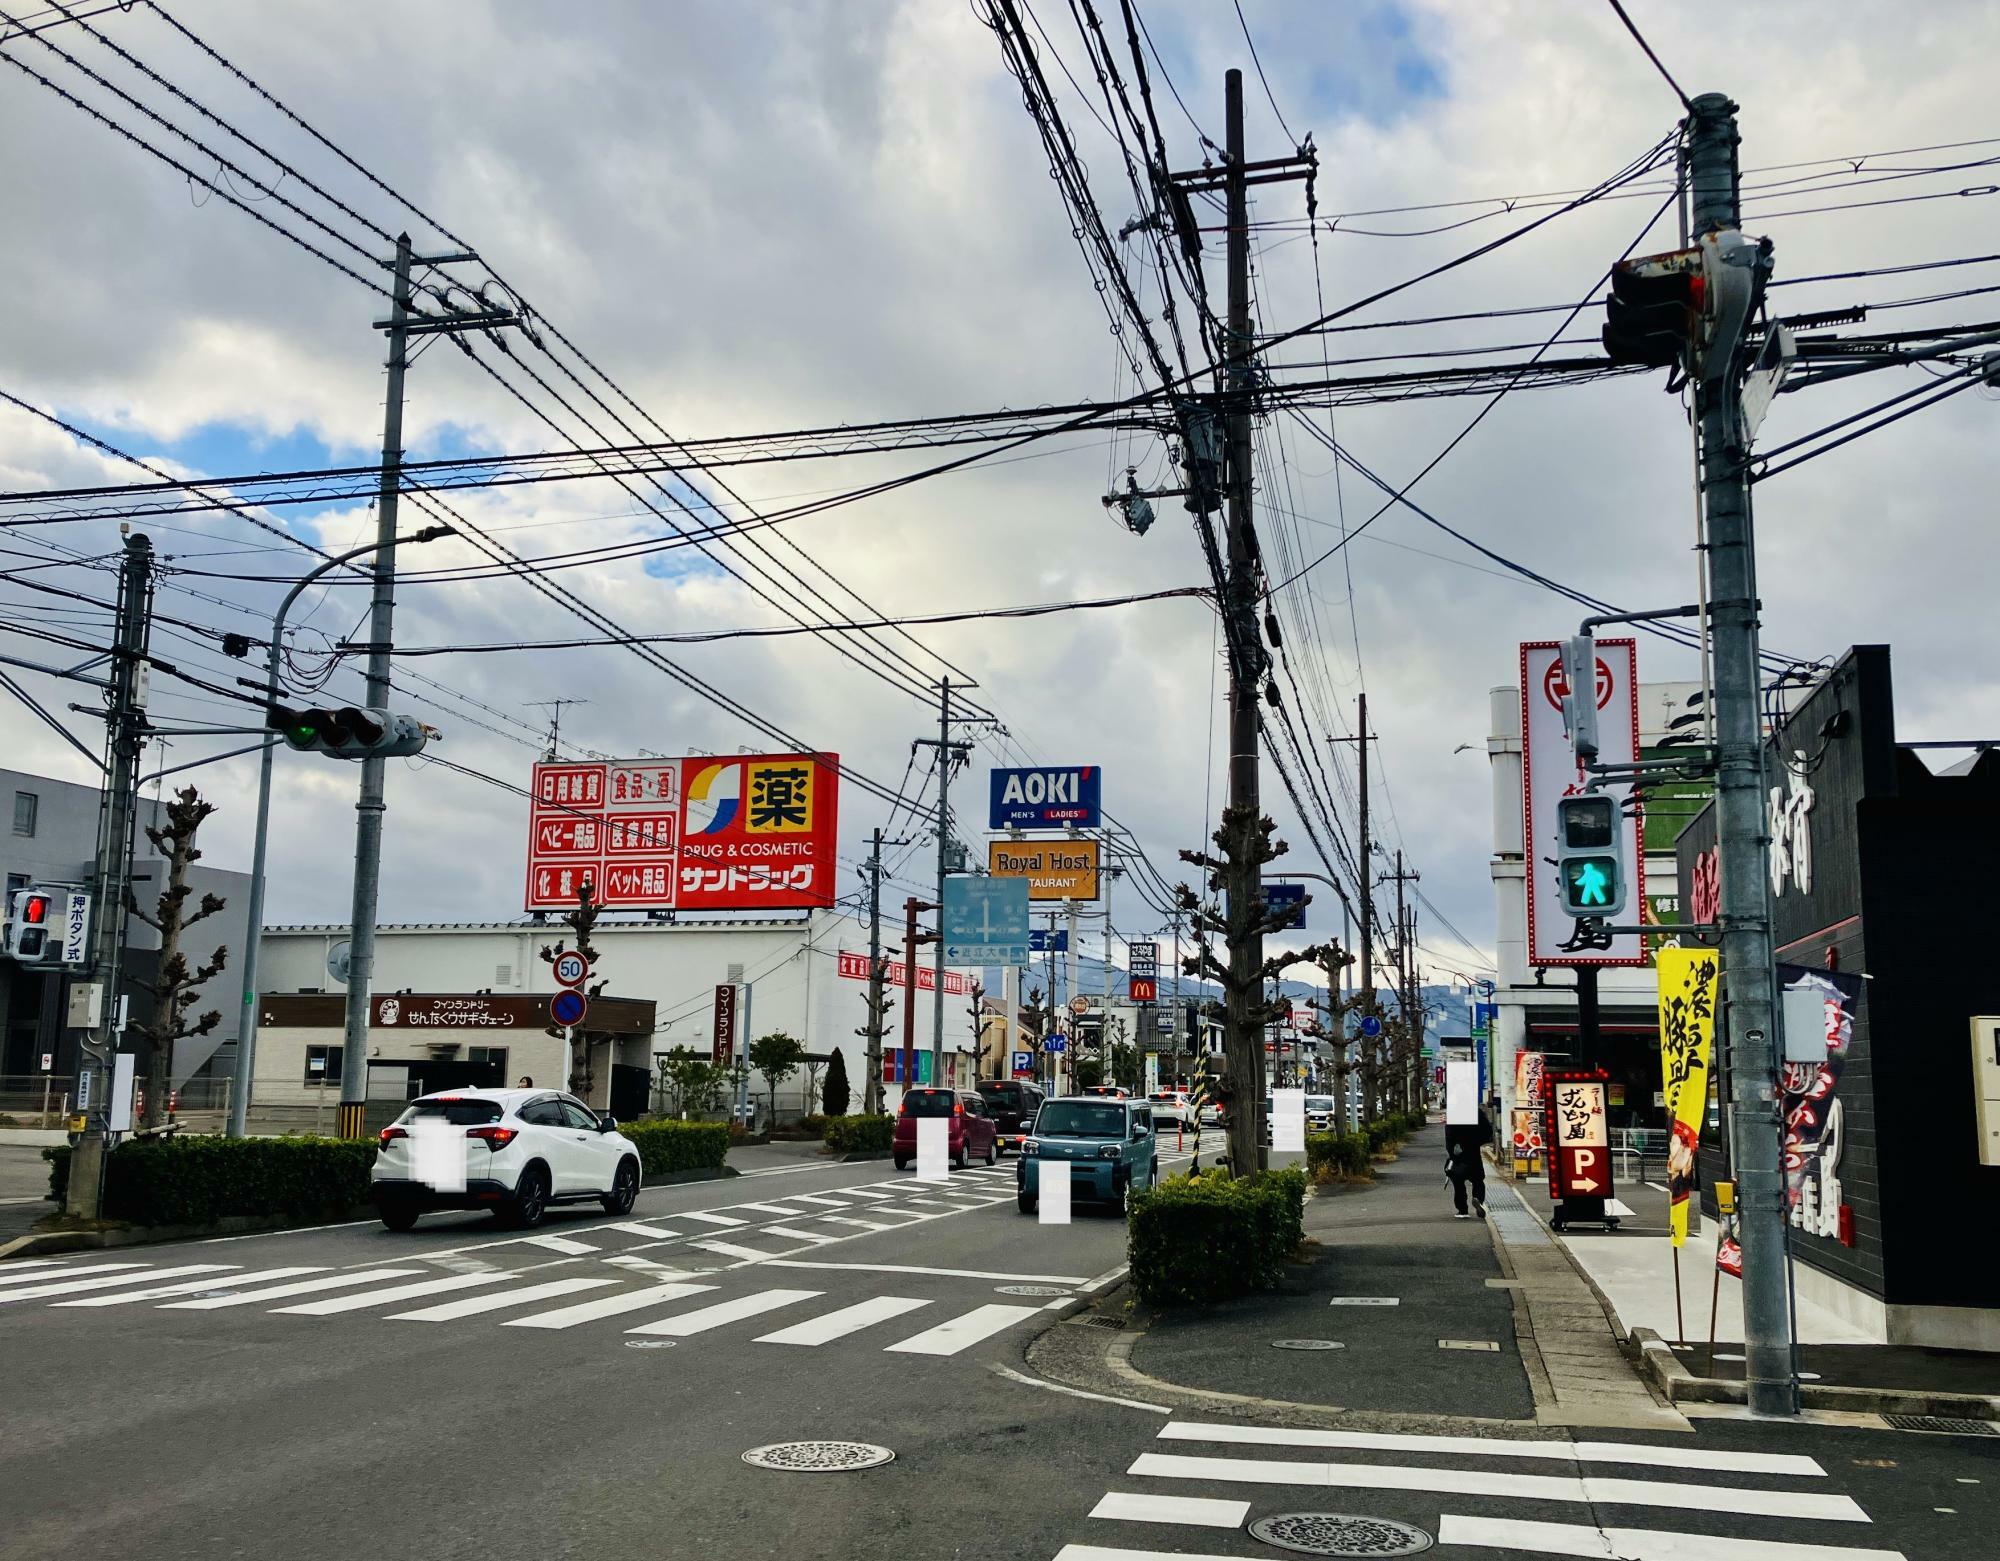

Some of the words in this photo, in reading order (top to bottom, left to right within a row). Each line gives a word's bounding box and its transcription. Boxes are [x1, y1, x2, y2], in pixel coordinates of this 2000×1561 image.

[543, 774, 598, 801] 日用雑貨
[615, 772, 670, 799] 食品・酒
[750, 768, 808, 827] 薬
[1002, 772, 1079, 804] AOKI
[1011, 811, 1035, 819] MEN'S
[541, 823, 595, 849] ベビー用品
[612, 821, 668, 848] 医療用品
[684, 844, 723, 857] DRUG
[727, 844, 738, 857] &
[740, 842, 814, 856] COSMETIC
[996, 853, 1042, 873] Royal
[1049, 852, 1091, 871] Host
[610, 868, 665, 894] ペット用品
[681, 864, 815, 892] サンドラッグ
[1029, 878, 1077, 888] TAURANT
[67, 896, 86, 961] 押ボタン式
[560, 961, 580, 977] 50
[408, 1011, 514, 1025] せんたくウサギチェーン
[433, 1000, 491, 1010] コインランドリー
[1014, 1052, 1030, 1070] P
[1574, 1149, 1595, 1175] P
